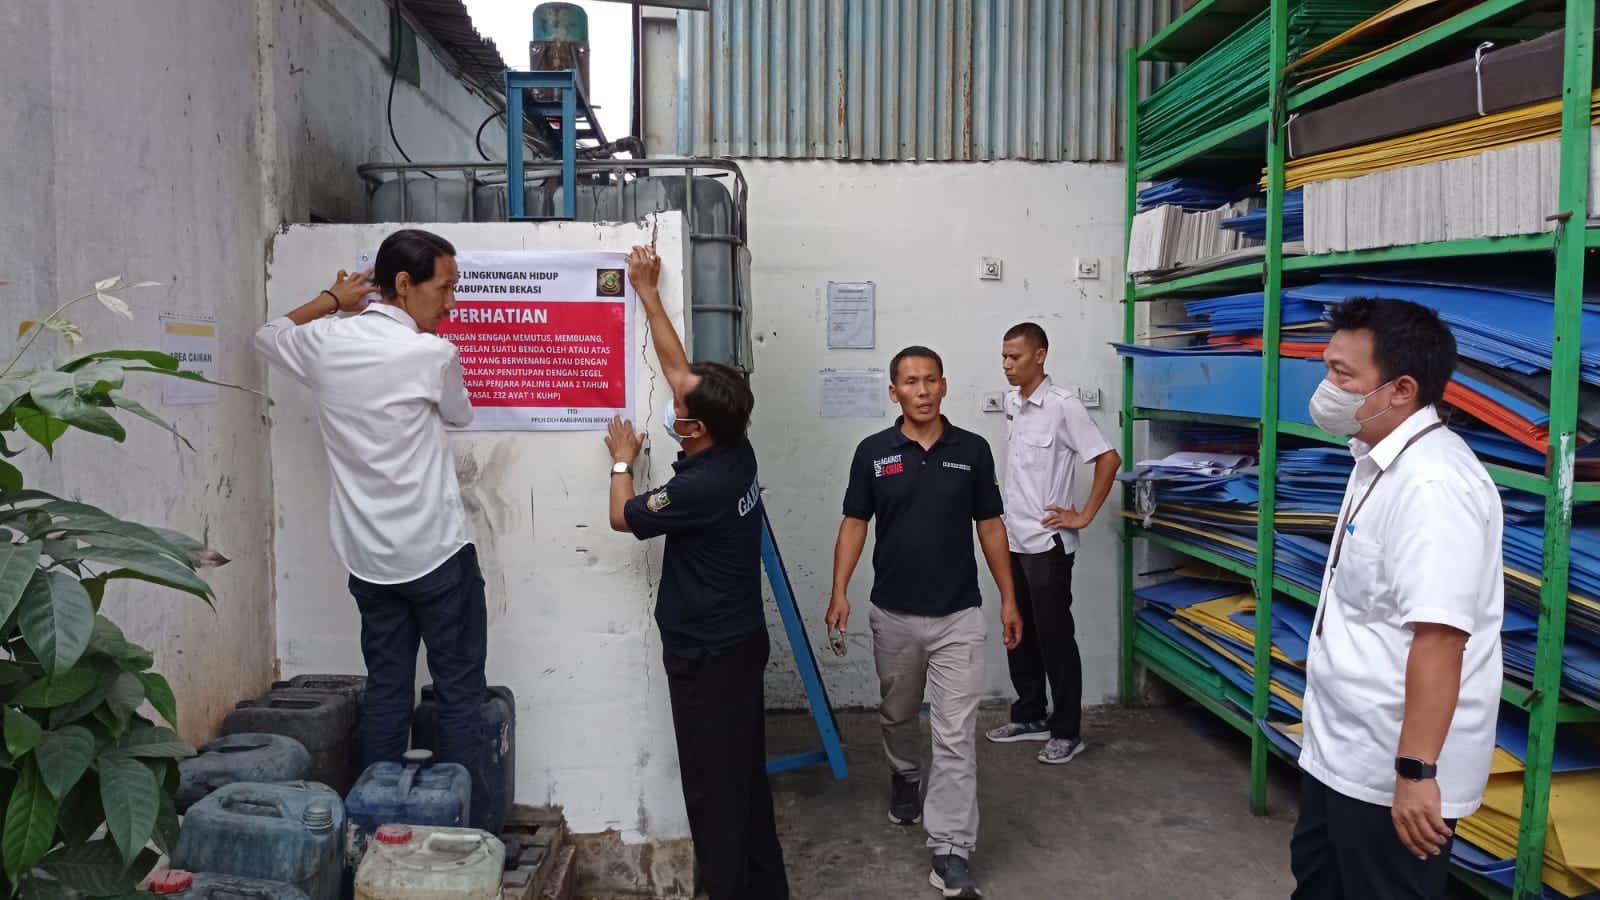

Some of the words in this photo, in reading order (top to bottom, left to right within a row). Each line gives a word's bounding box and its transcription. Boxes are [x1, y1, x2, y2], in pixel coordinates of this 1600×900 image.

[463, 271, 527, 280] LINGKUNGAN
[529, 271, 559, 281] HIDUP
[453, 284, 507, 294] KABUPATEN
[509, 285, 542, 294] BEKASI
[449, 308, 548, 324] PERHATIAN
[478, 333, 511, 342] SENGAJA
[459, 345, 490, 353] EGELAN
[491, 345, 517, 353] SUATU
[518, 345, 545, 354] BENDA
[546, 346, 567, 354] OLEH
[568, 346, 589, 354] ATAU
[590, 346, 611, 354] ATAS
[478, 356, 502, 365] YANG
[502, 356, 551, 365] BERWENANG
[552, 357, 573, 365] ATAU
[574, 358, 608, 366] DENGAN
[463, 368, 495, 376] GALKAN
[496, 368, 544, 377] PENUTUPAN
[546, 369, 579, 377] DENGAN
[486, 379, 519, 389] PENJARA
[521, 380, 550, 388] PALING
[582, 381, 609, 389] TAHUN
[467, 391, 492, 399] PASAL
[493, 391, 506, 399] 232
[508, 391, 529, 399] AYAT
[531, 391, 535, 399] 1
[536, 391, 561, 400] KUHP)
